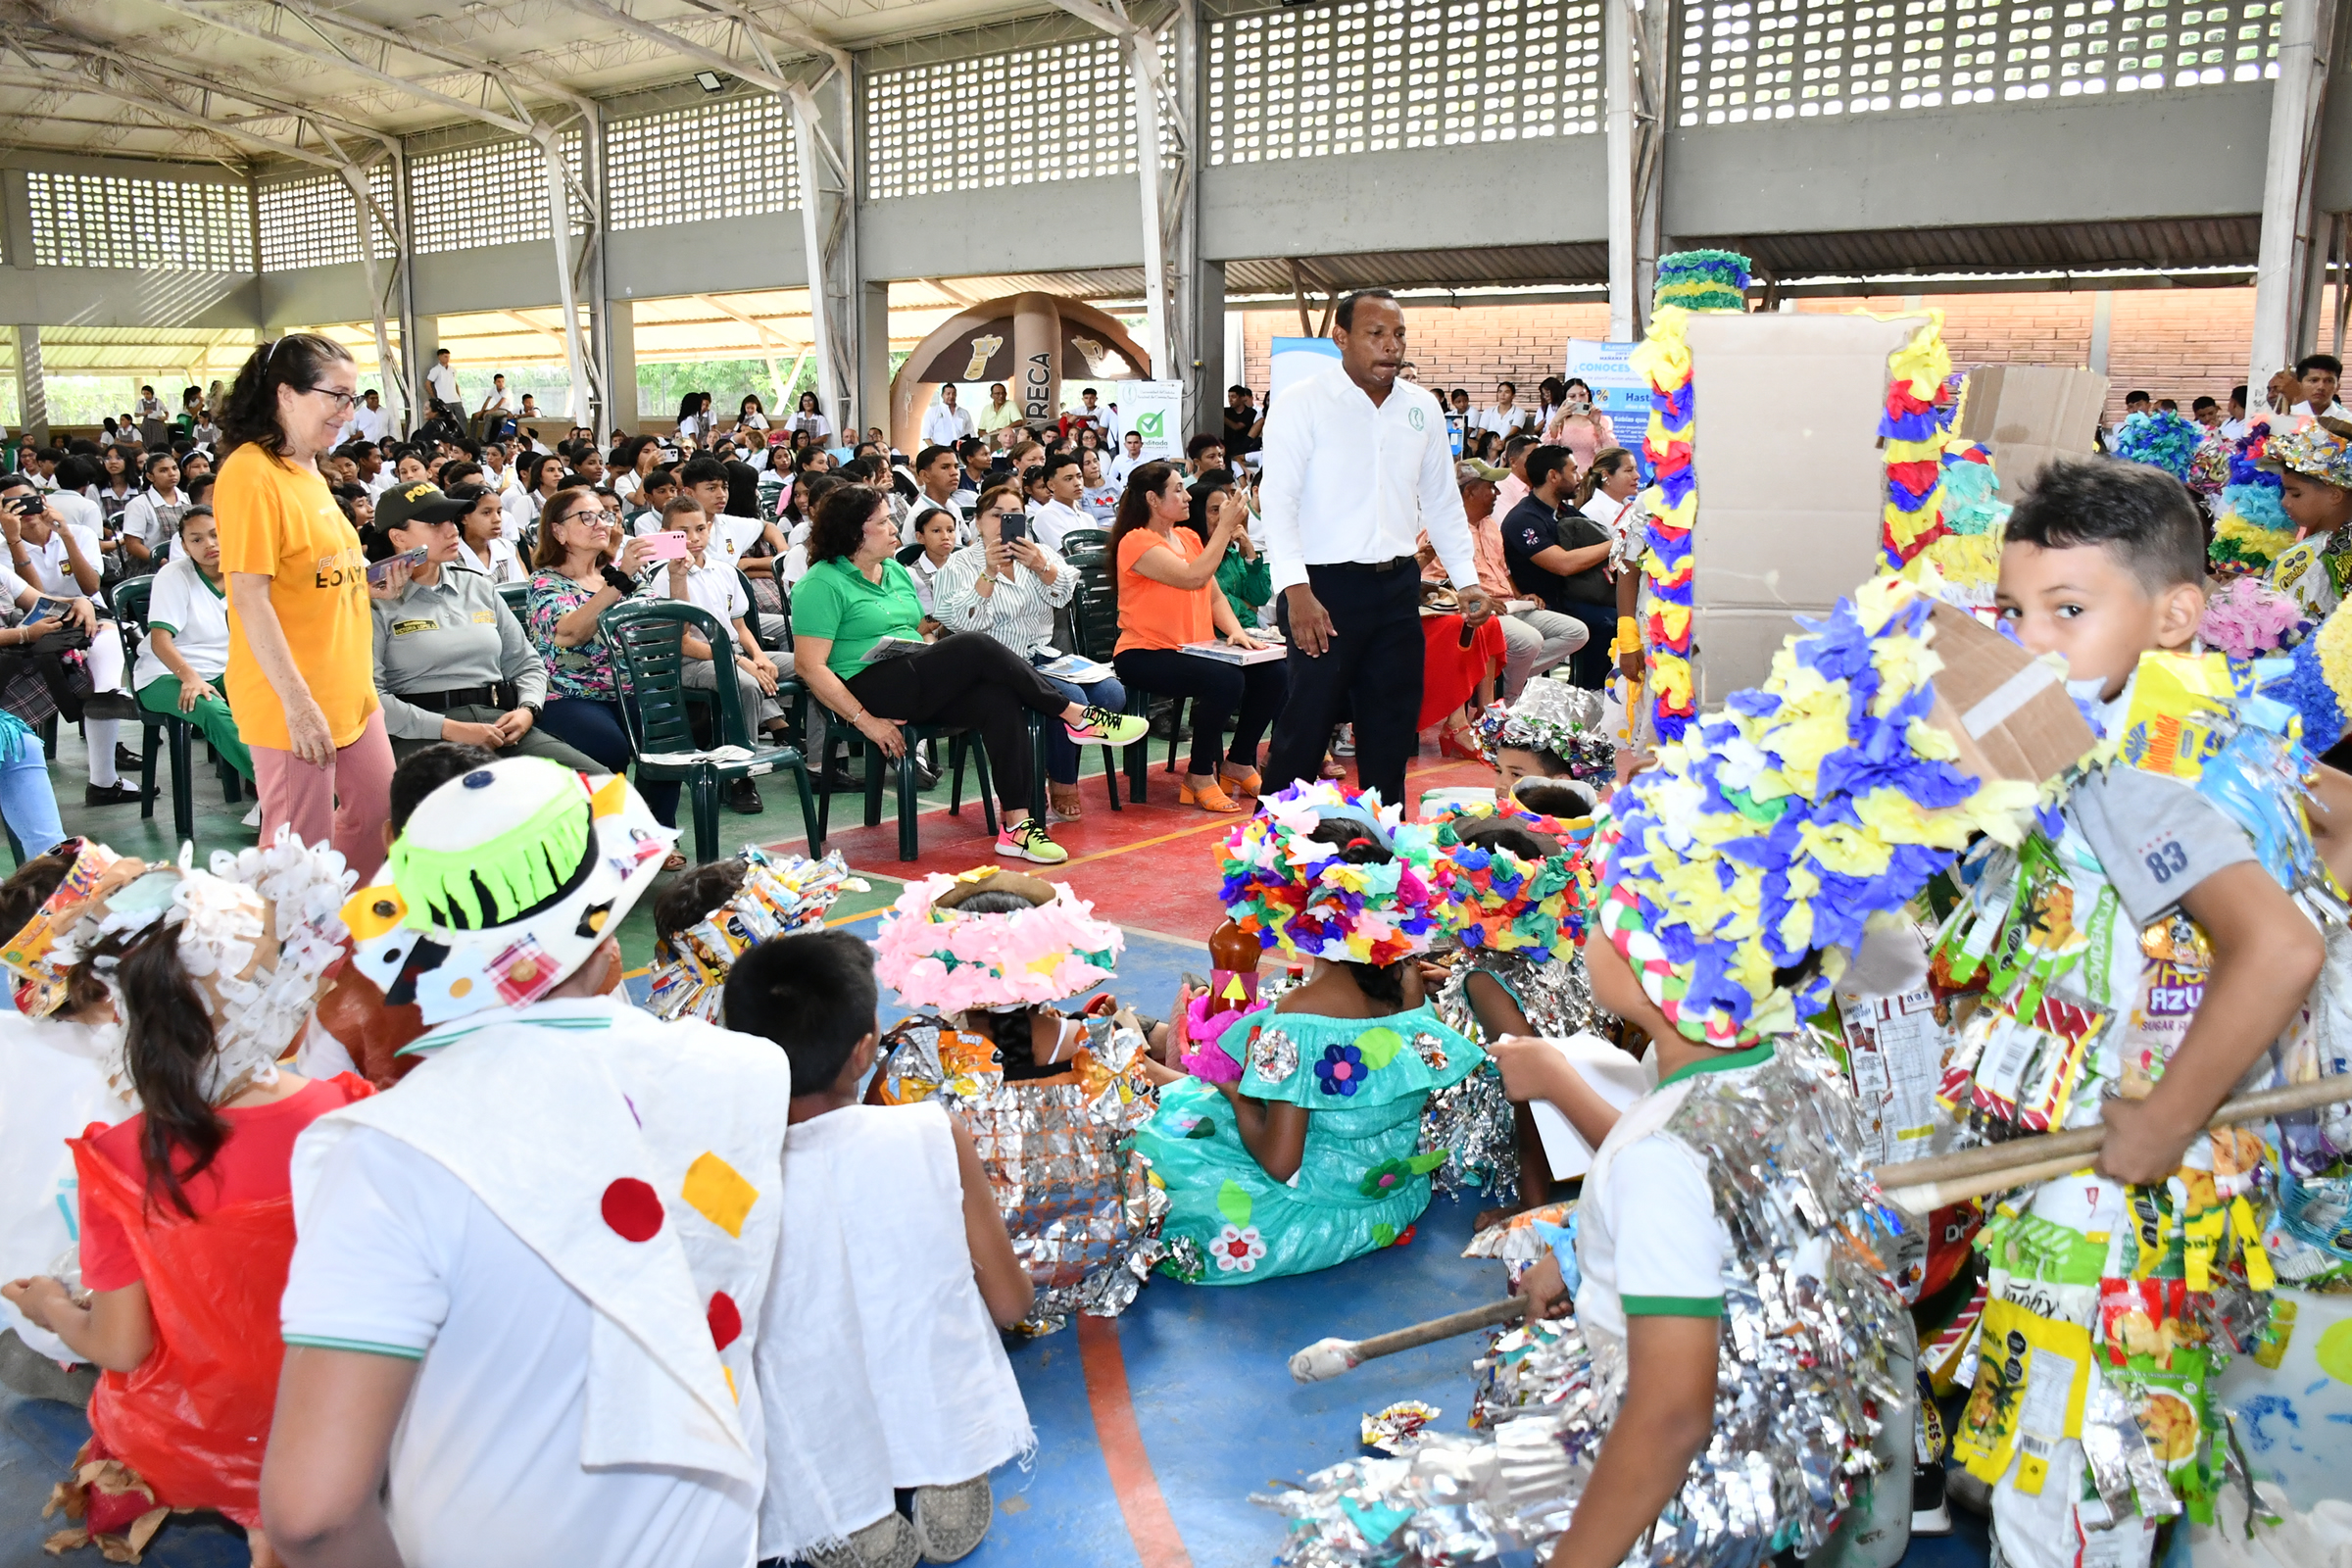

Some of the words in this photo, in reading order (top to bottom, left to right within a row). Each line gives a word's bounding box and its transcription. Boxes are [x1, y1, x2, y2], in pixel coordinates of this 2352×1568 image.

[1025, 353, 1051, 425] RECA
[1626, 392, 1649, 402] Hast
[2145, 840, 2188, 884] 83
[2141, 1019, 2174, 1031] SUGAR
